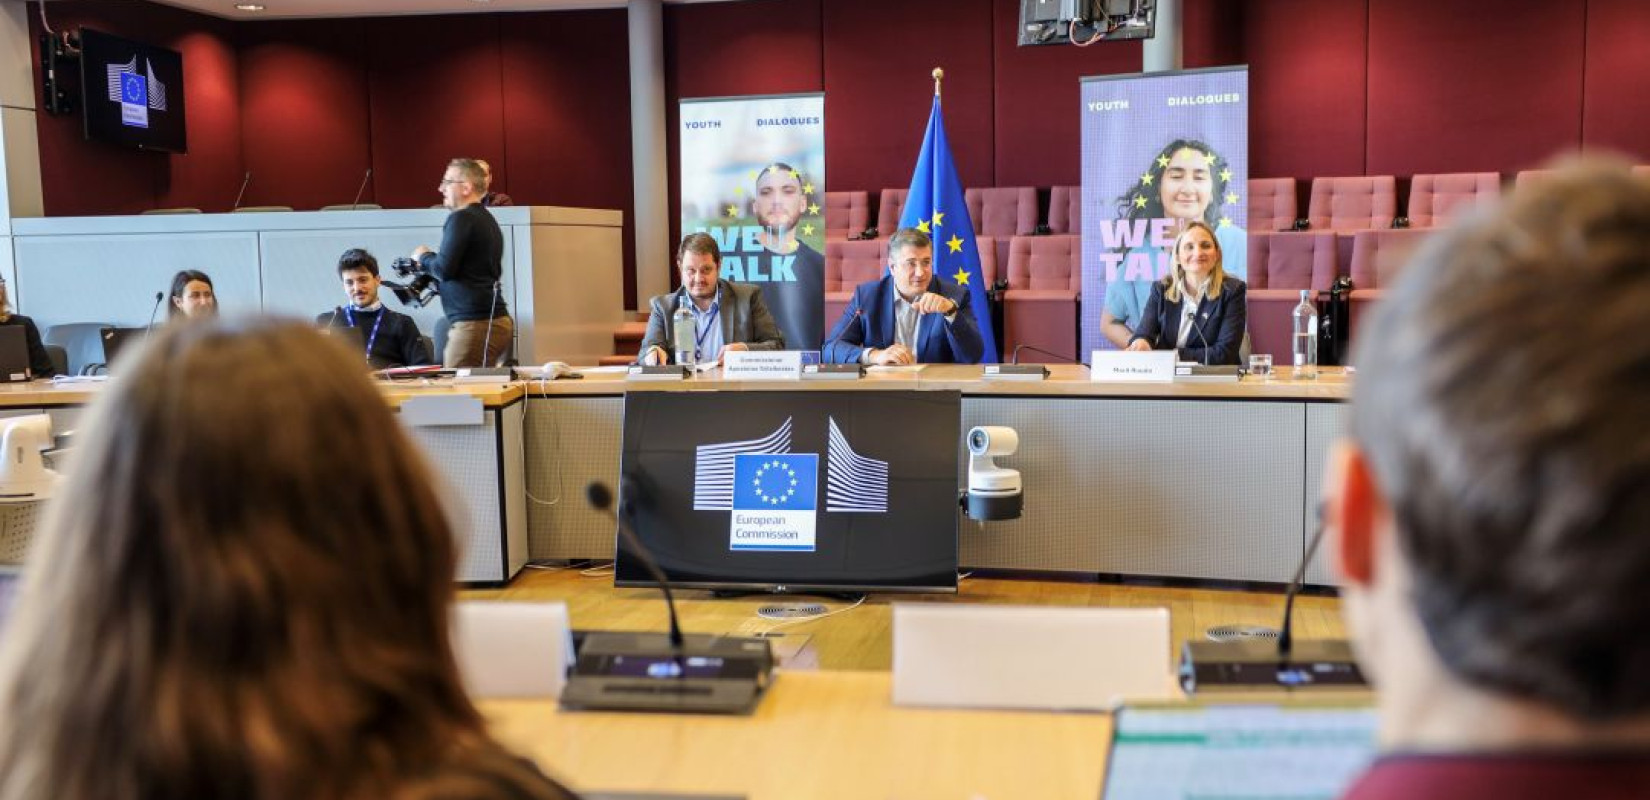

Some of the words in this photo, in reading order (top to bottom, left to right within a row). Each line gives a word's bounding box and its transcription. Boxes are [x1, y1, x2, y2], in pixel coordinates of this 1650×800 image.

[1088, 100, 1130, 112] YOUTH
[1167, 93, 1241, 106] DIALOGUES
[685, 120, 722, 129] YOUTH
[756, 117, 820, 127] DIALOGUES
[719, 255, 798, 282] ALK
[1100, 251, 1169, 281] TA
[736, 514, 786, 527] European
[735, 529, 799, 540] Commission
